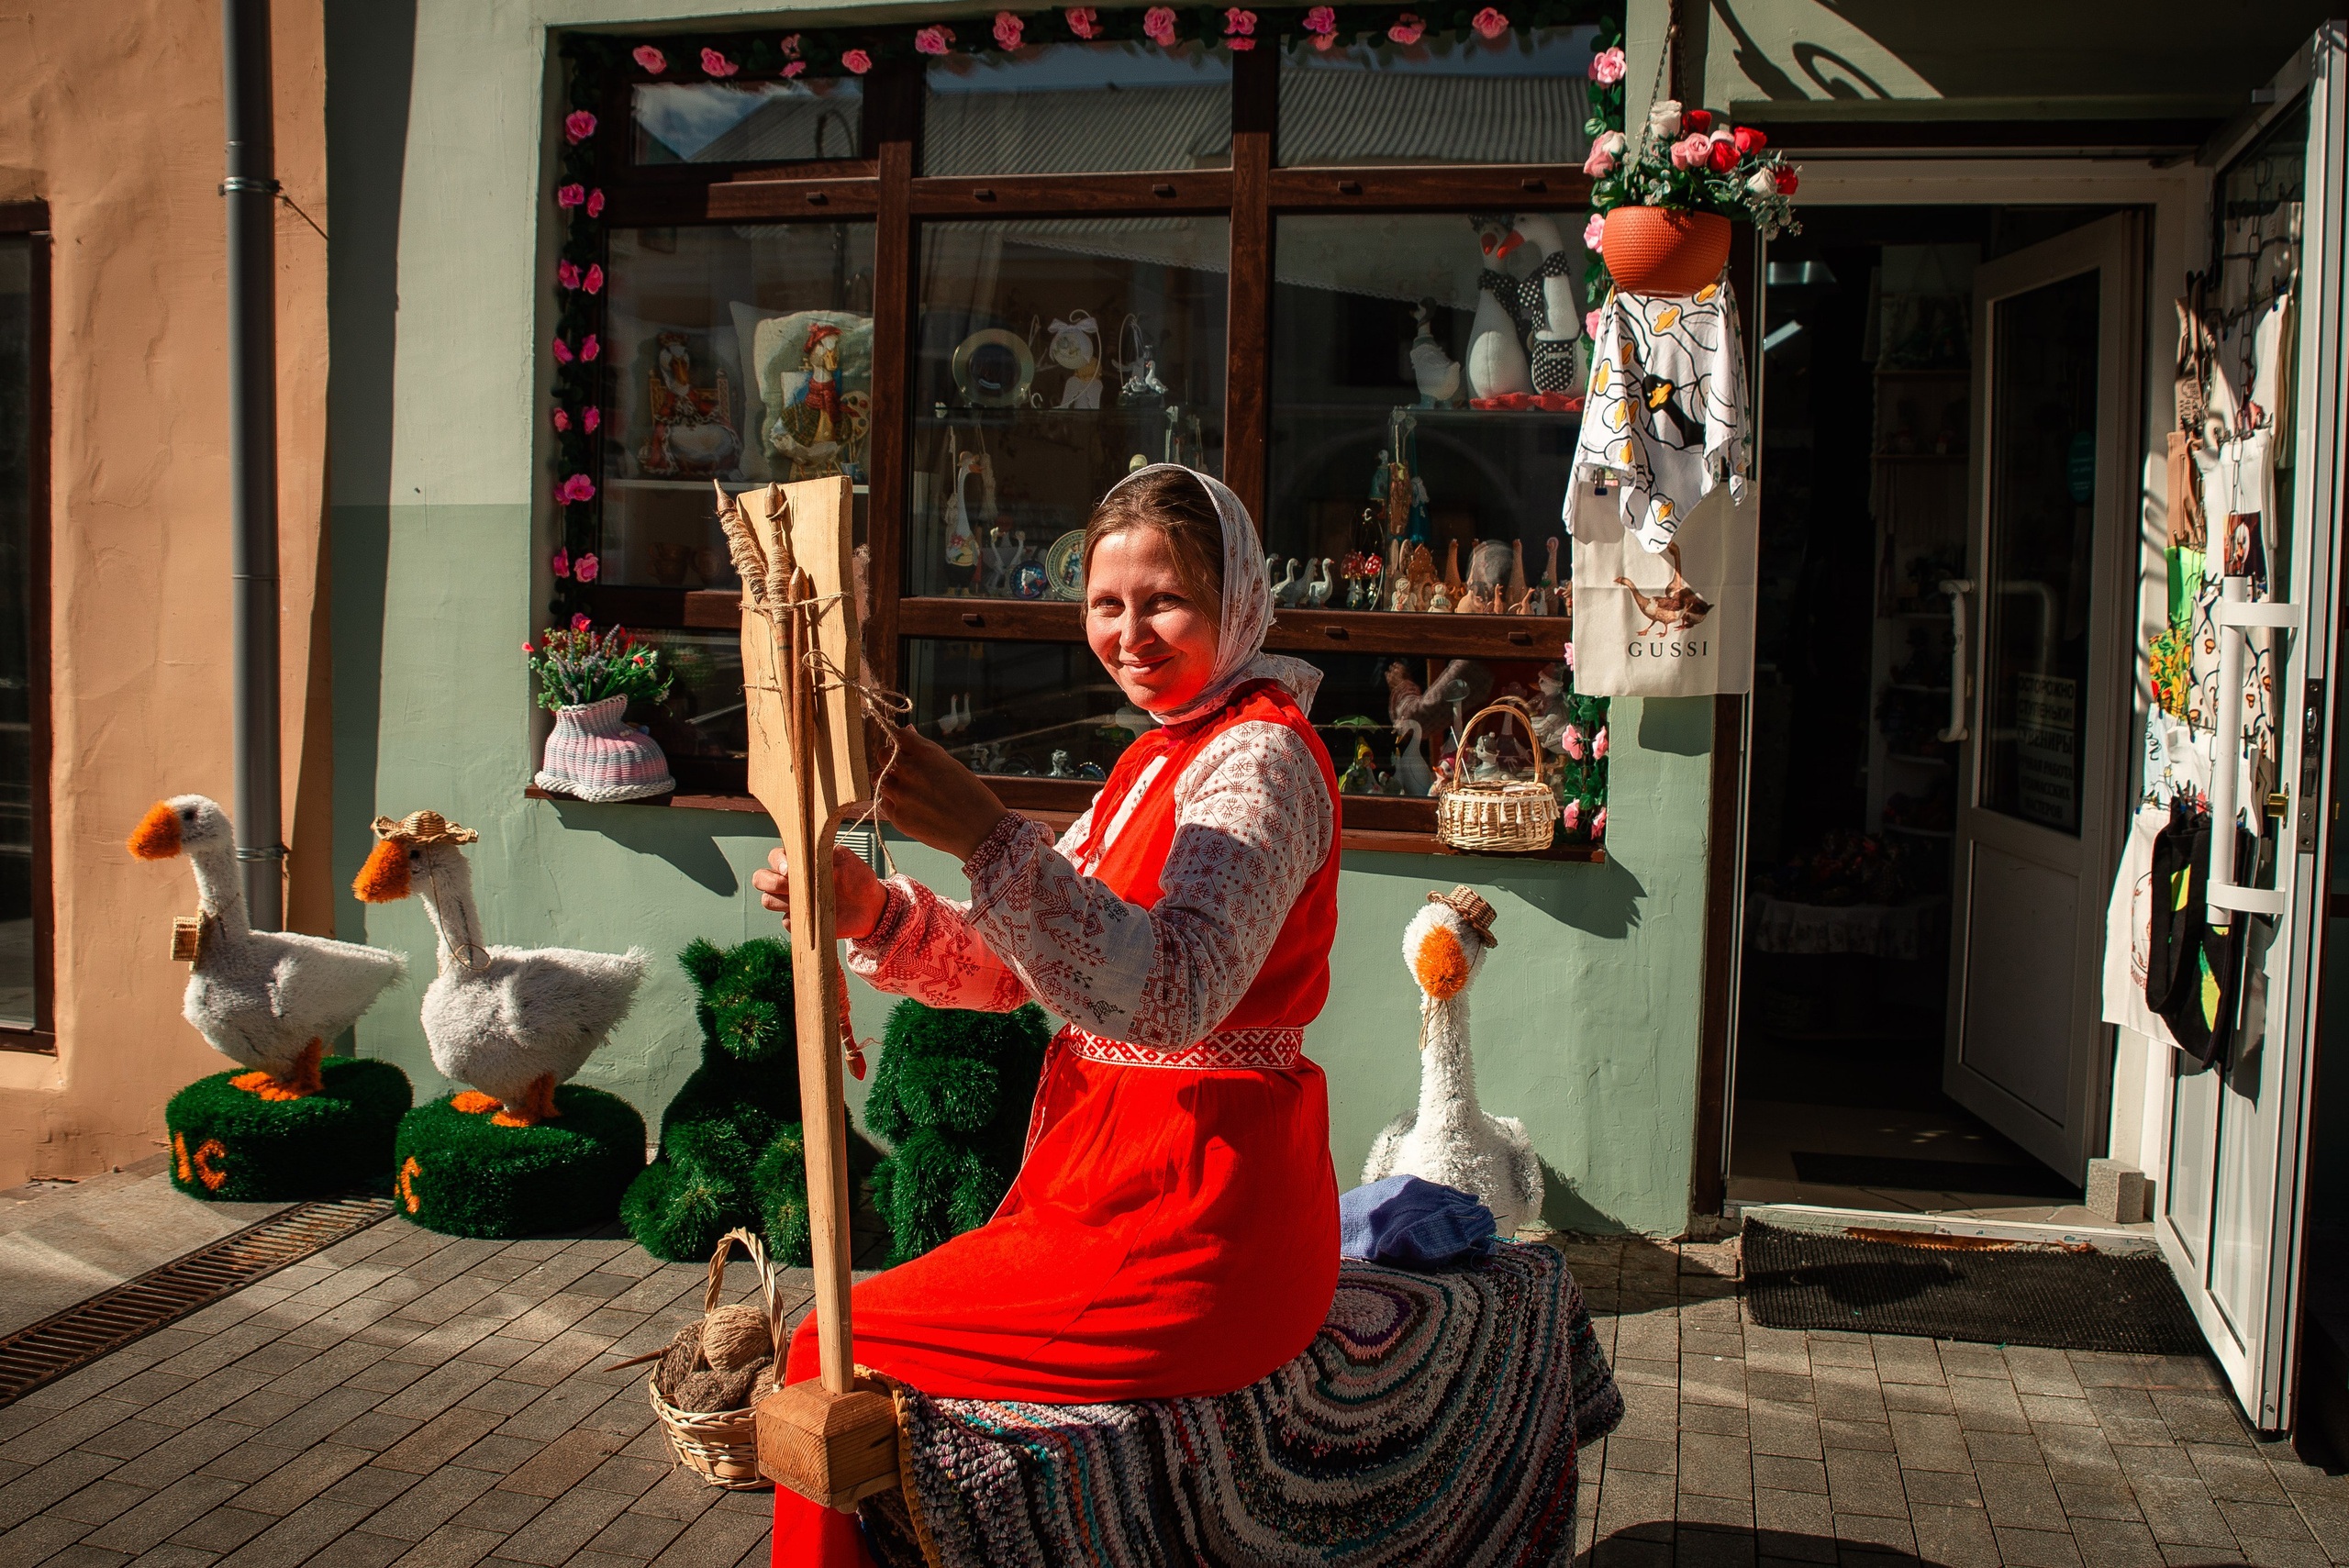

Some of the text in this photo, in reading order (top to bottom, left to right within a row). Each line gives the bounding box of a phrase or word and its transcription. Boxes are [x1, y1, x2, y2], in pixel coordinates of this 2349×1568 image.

[1627, 640, 1708, 658] GUSSI
[2019, 676, 2075, 700] ОСТОРОЖНО
[2019, 725, 2073, 755] СУВЕНИРЫ
[2043, 761, 2074, 781] РАБОТА
